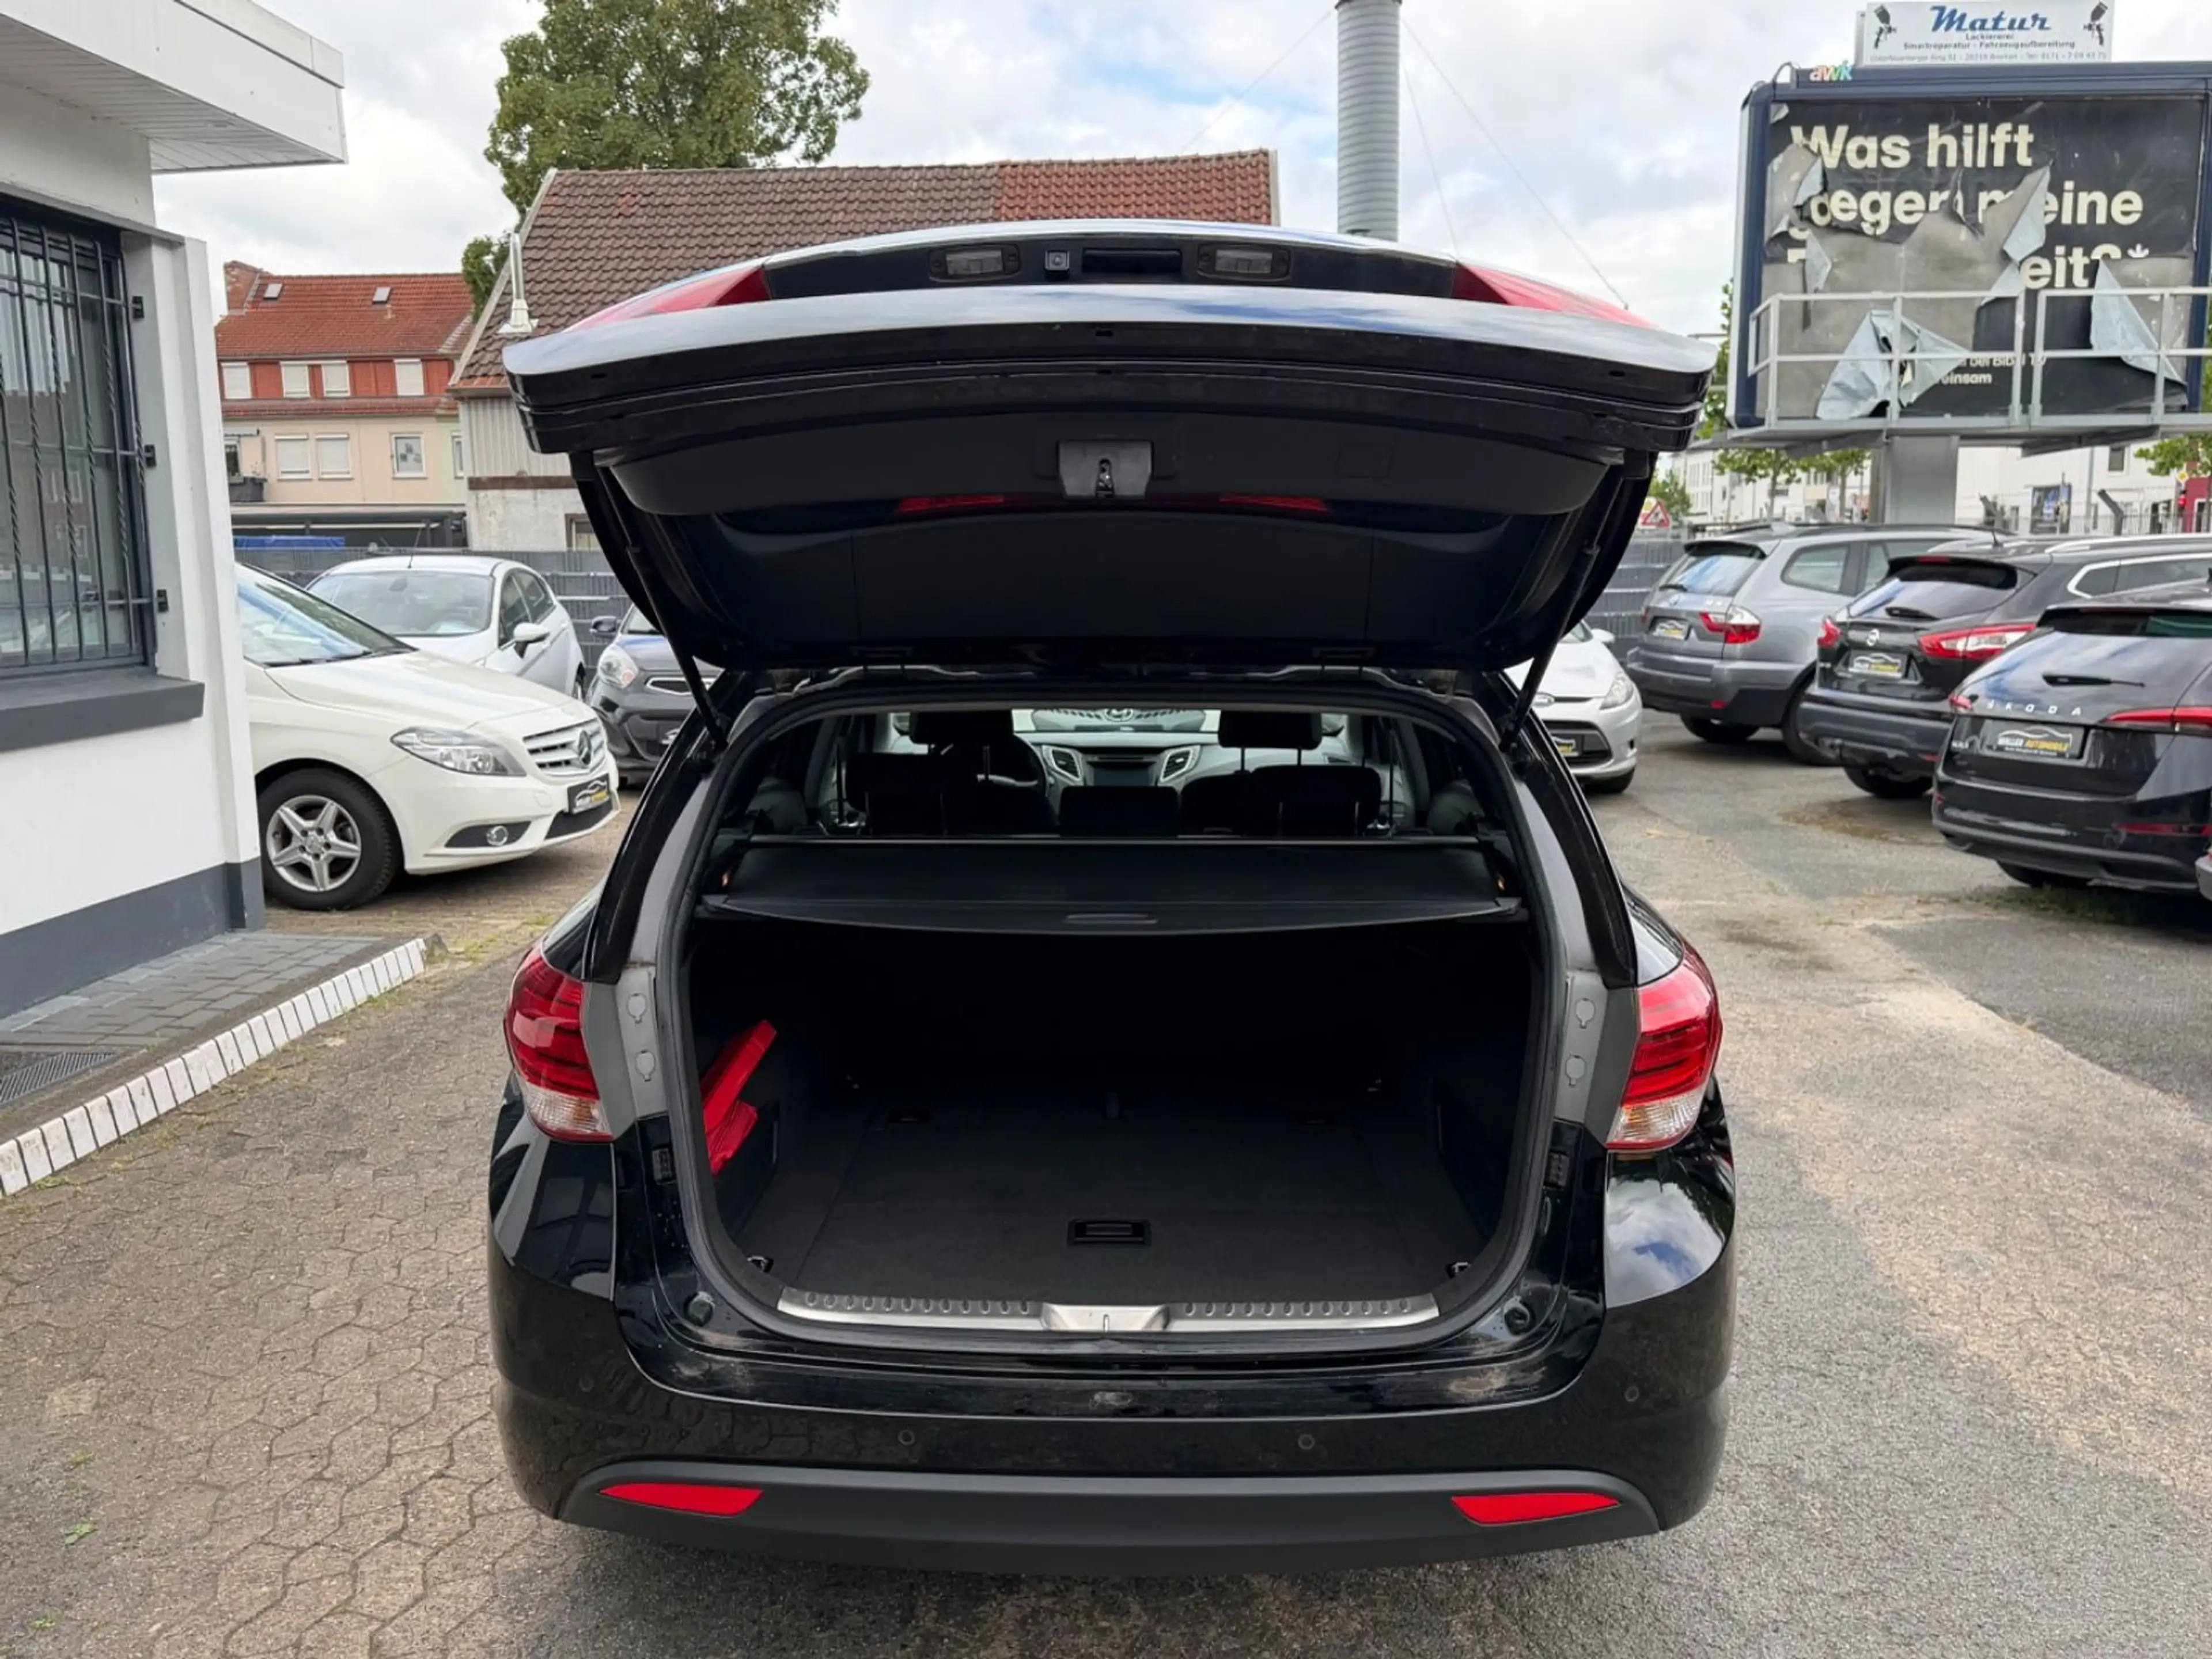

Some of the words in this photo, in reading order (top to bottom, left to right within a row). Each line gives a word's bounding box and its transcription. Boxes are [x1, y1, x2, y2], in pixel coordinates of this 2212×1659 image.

[1930, 5, 2051, 32] Matur
[1809, 60, 1853, 81] awk
[1790, 125, 1911, 169] Was
[1927, 123, 2034, 168] hilft
